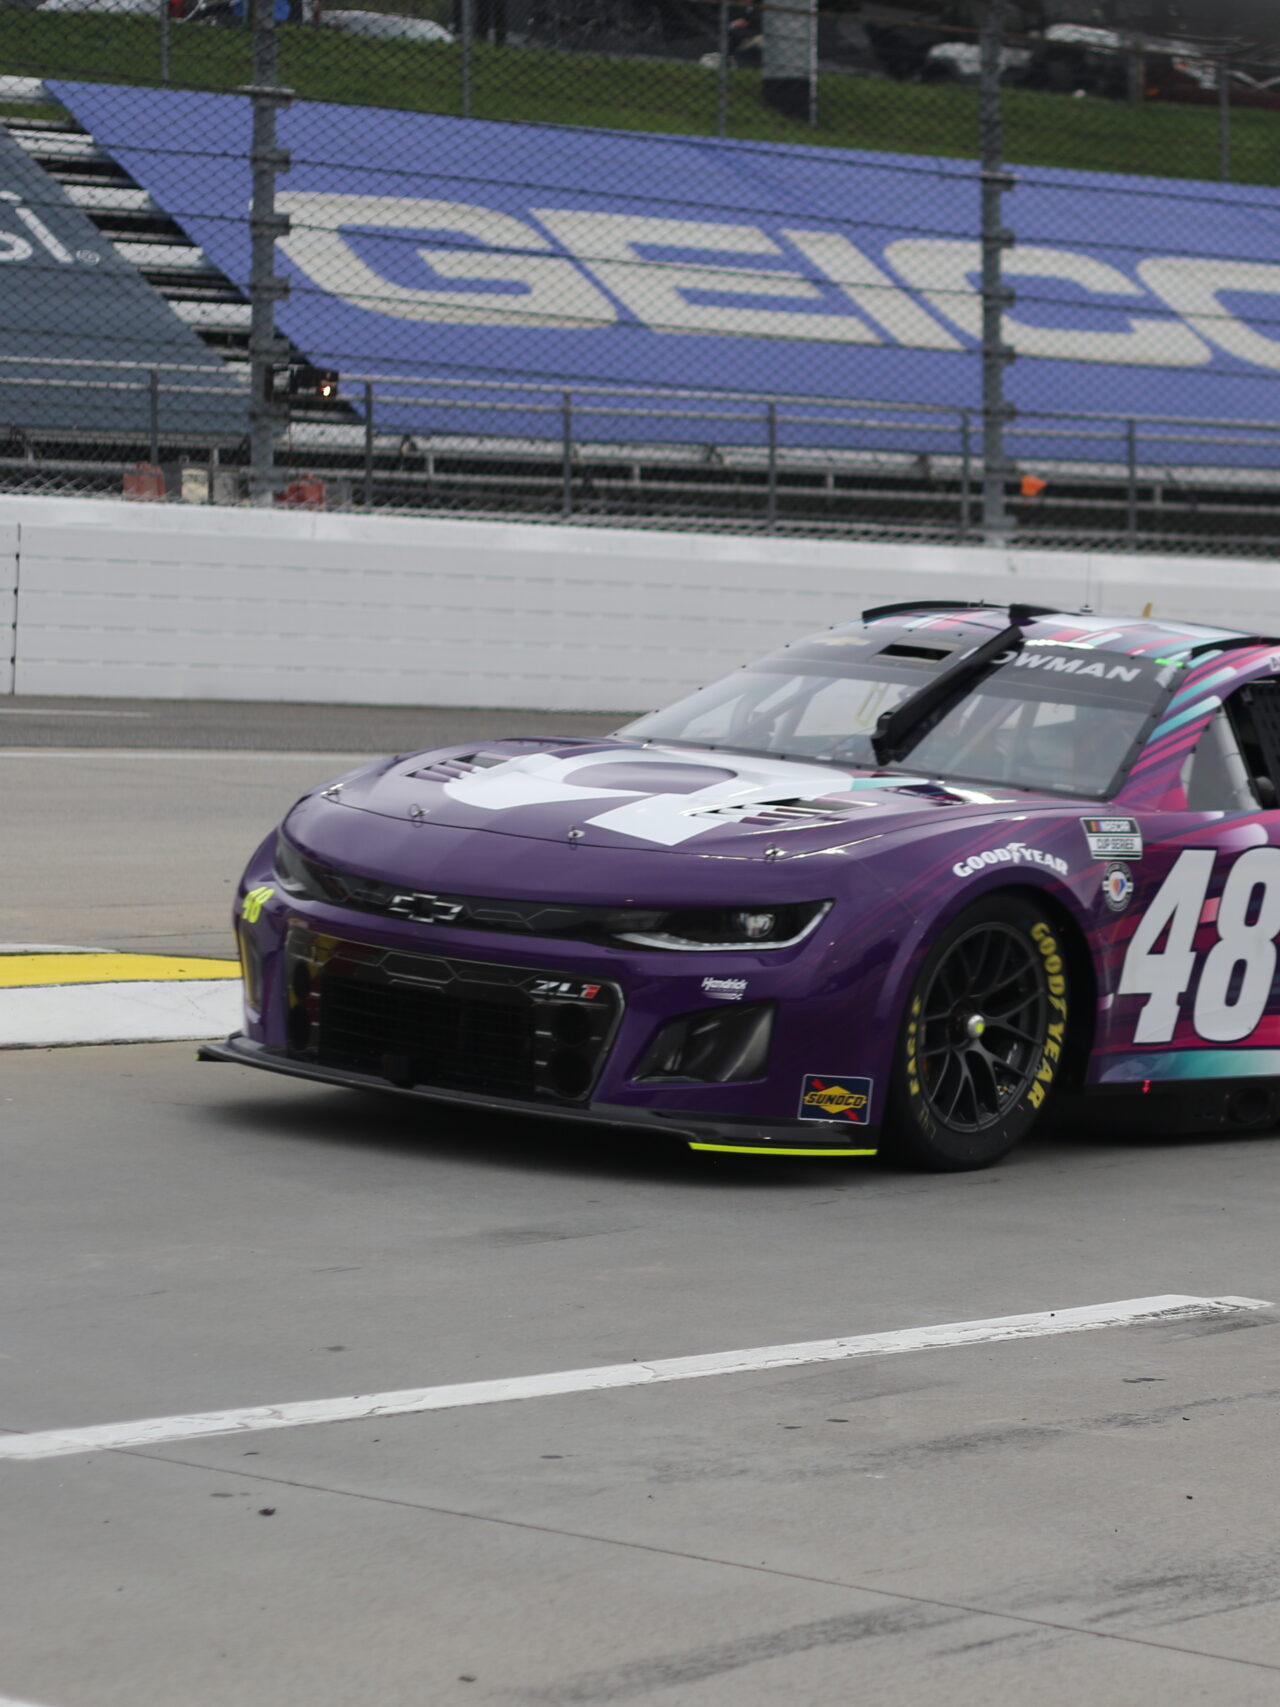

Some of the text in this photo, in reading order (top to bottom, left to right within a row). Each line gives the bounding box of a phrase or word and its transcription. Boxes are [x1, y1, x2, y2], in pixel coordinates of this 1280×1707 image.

[960, 647, 1142, 683] OWMAN
[952, 842, 1069, 878] GOODYEAR
[529, 979, 601, 999] ZL1
[1030, 922, 1067, 1109] GOODYEAR
[807, 1093, 863, 1107] SUNOCO
